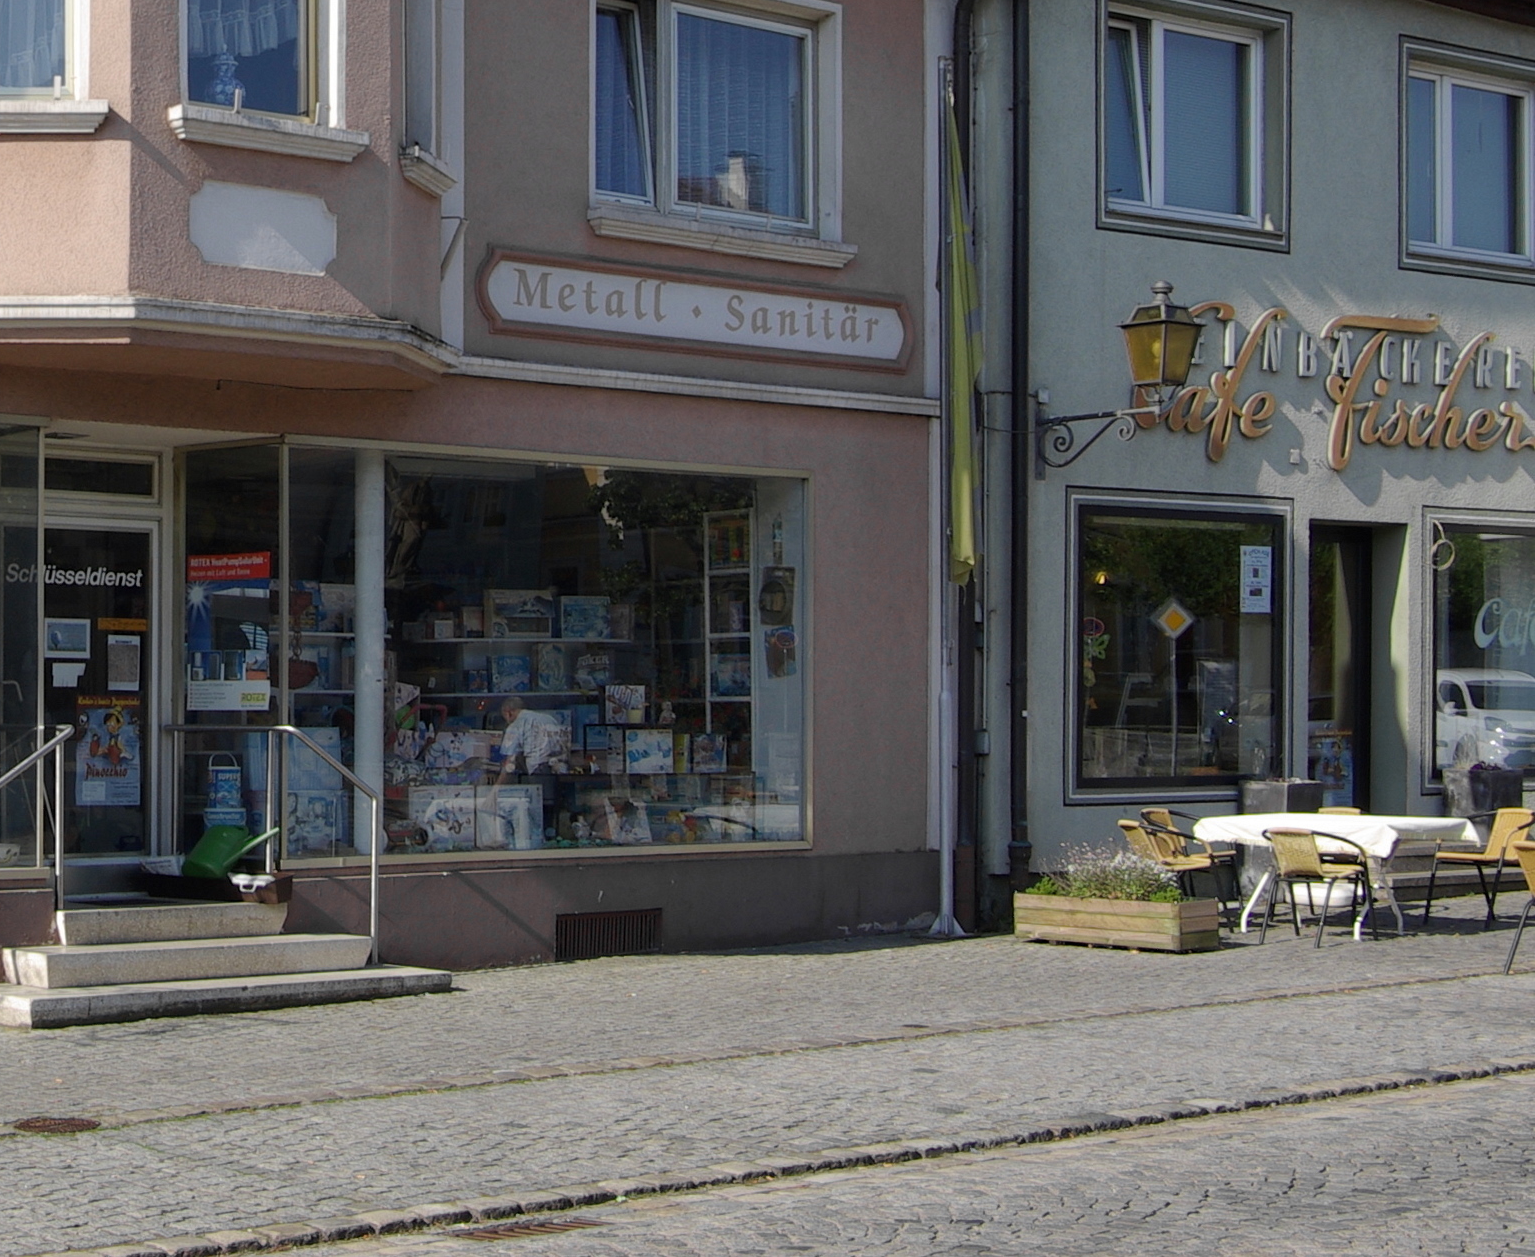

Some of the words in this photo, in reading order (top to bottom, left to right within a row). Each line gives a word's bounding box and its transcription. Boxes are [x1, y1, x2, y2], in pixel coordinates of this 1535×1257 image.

[512, 267, 667, 324] Metall
[723, 294, 880, 344] Sanitär
[1473, 597, 1535, 656] Caf
[84, 762, 129, 781] Pinocchio
